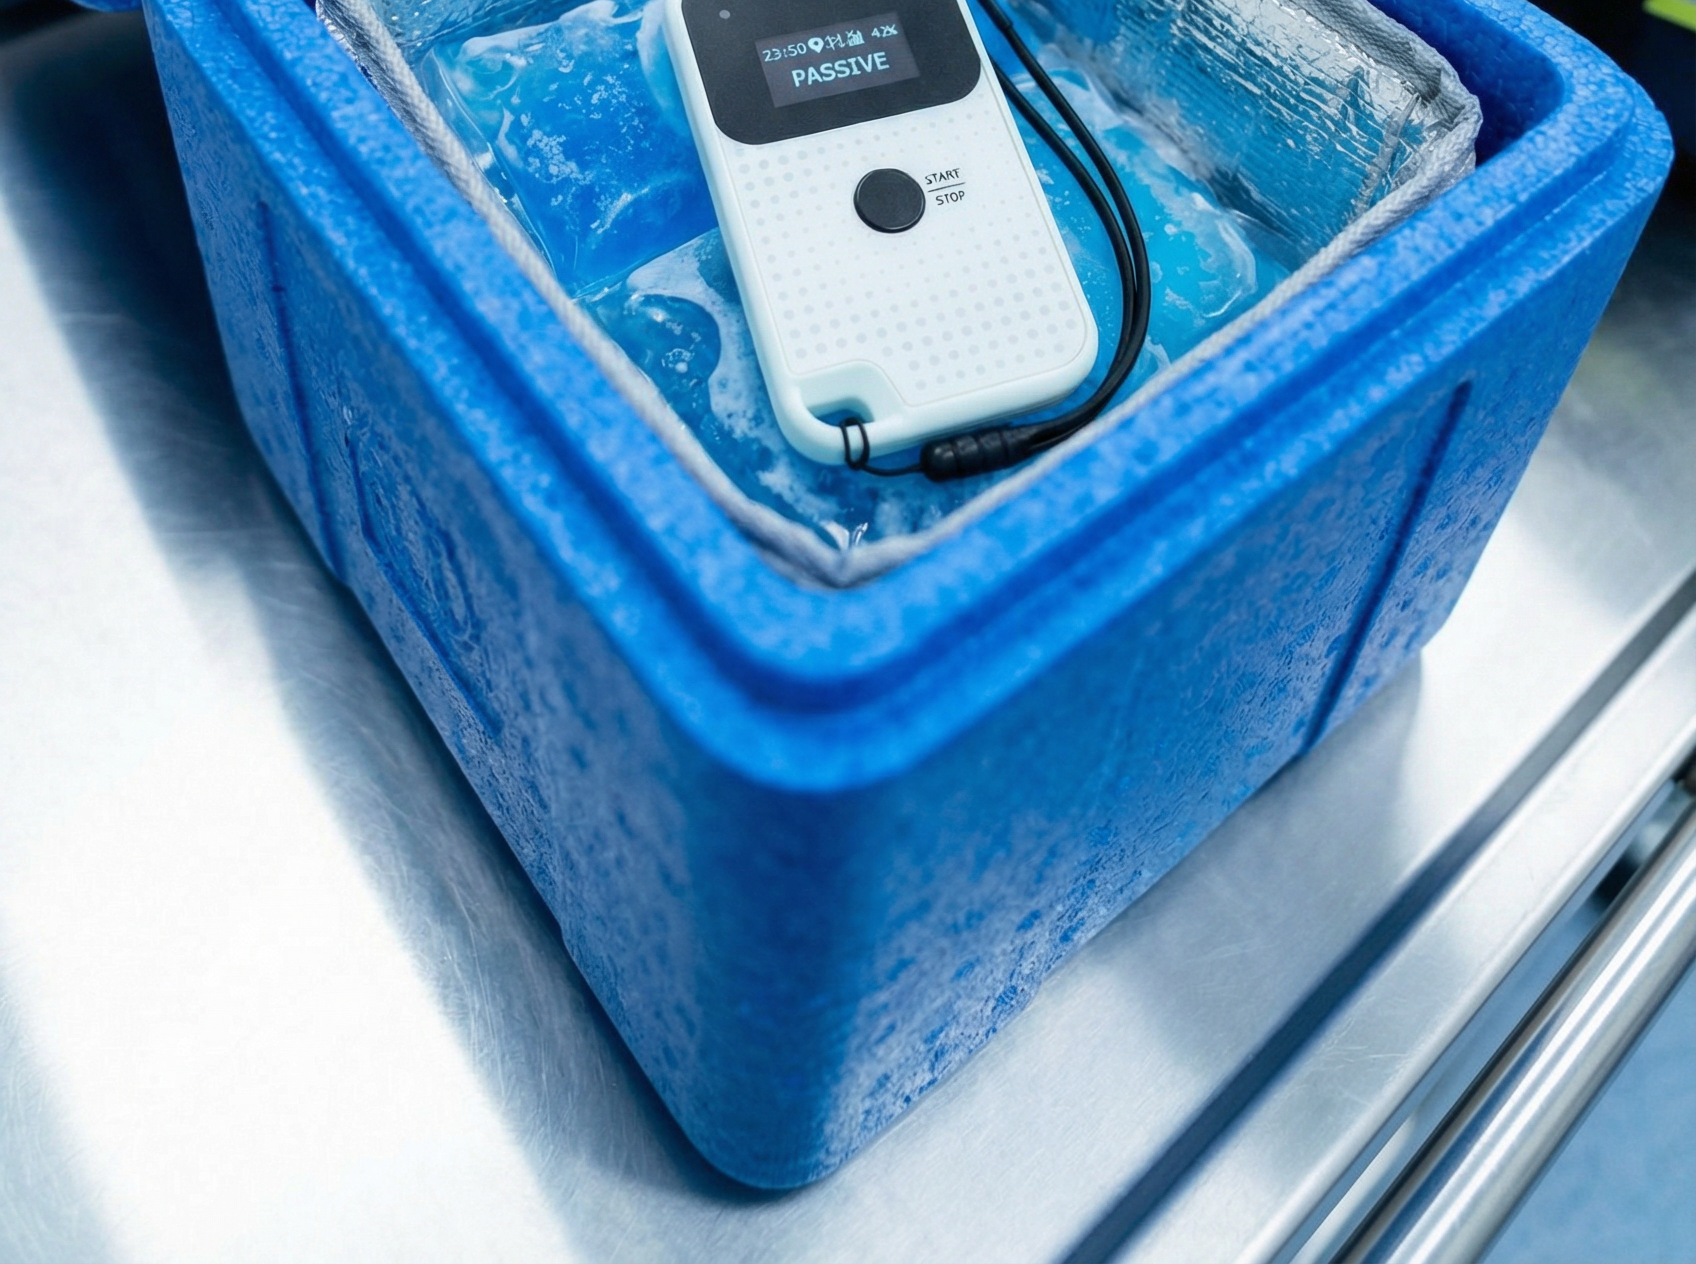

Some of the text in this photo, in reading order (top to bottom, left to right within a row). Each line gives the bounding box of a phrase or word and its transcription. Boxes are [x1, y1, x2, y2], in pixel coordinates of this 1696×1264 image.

[762, 42, 807, 62] 23:50
[791, 51, 890, 88] PASSIVE
[925, 167, 961, 185] START
[935, 190, 966, 206] STOP
